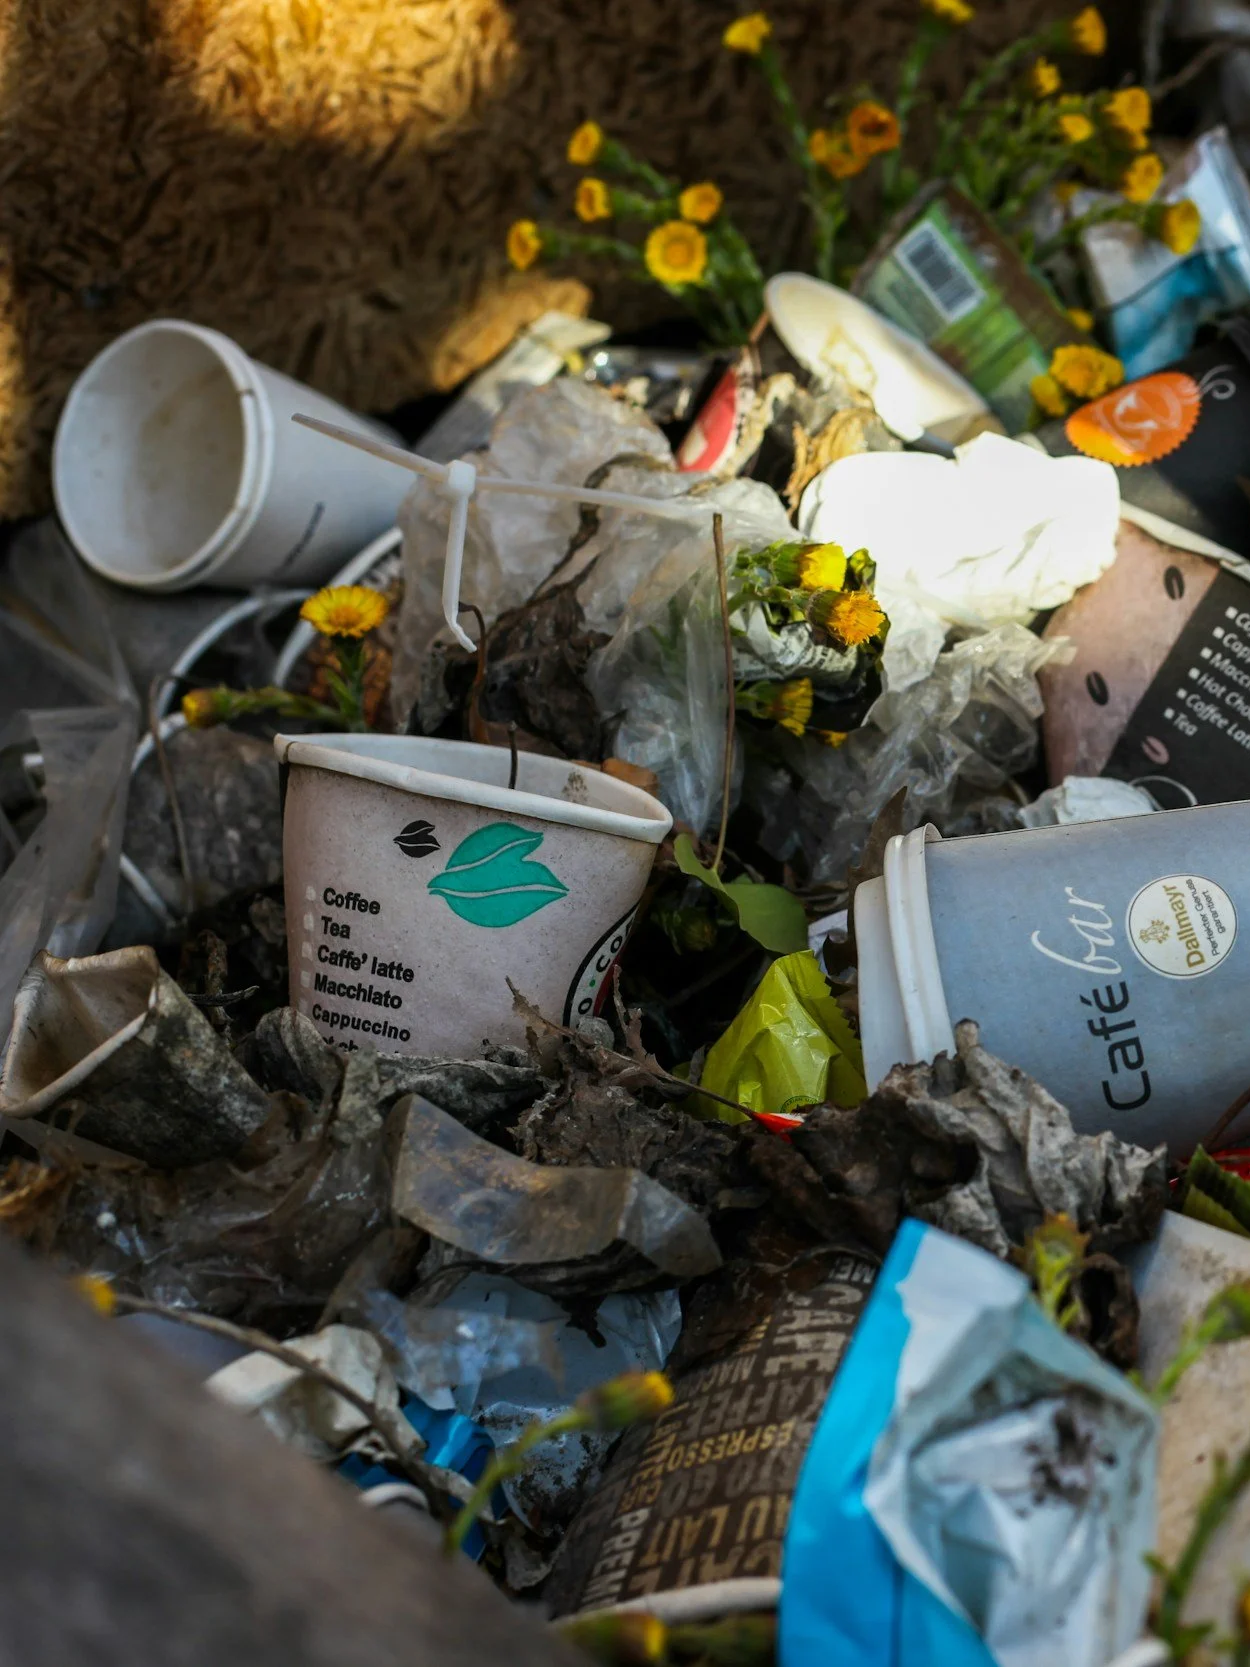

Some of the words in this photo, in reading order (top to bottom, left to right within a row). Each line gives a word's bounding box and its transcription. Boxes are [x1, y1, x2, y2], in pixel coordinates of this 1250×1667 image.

[1197, 672, 1227, 699] Hot
[1173, 711, 1199, 737] Tea
[1185, 693, 1230, 730] Coffee
[322, 886, 381, 916] Coffee
[1185, 878, 1204, 912] Genuss
[1202, 889, 1227, 934] garantiert
[320, 915, 351, 940] Tea
[1031, 885, 1123, 976] bar
[1162, 884, 1206, 969] Dallmayr
[1200, 913, 1220, 957] Perfekter
[370, 956, 415, 983] latte
[313, 972, 403, 1010] Macchiato
[312, 1003, 411, 1043] Cappuccino
[1080, 980, 1152, 1112] Café
[667, 1419, 797, 1473] ESPRESSO
